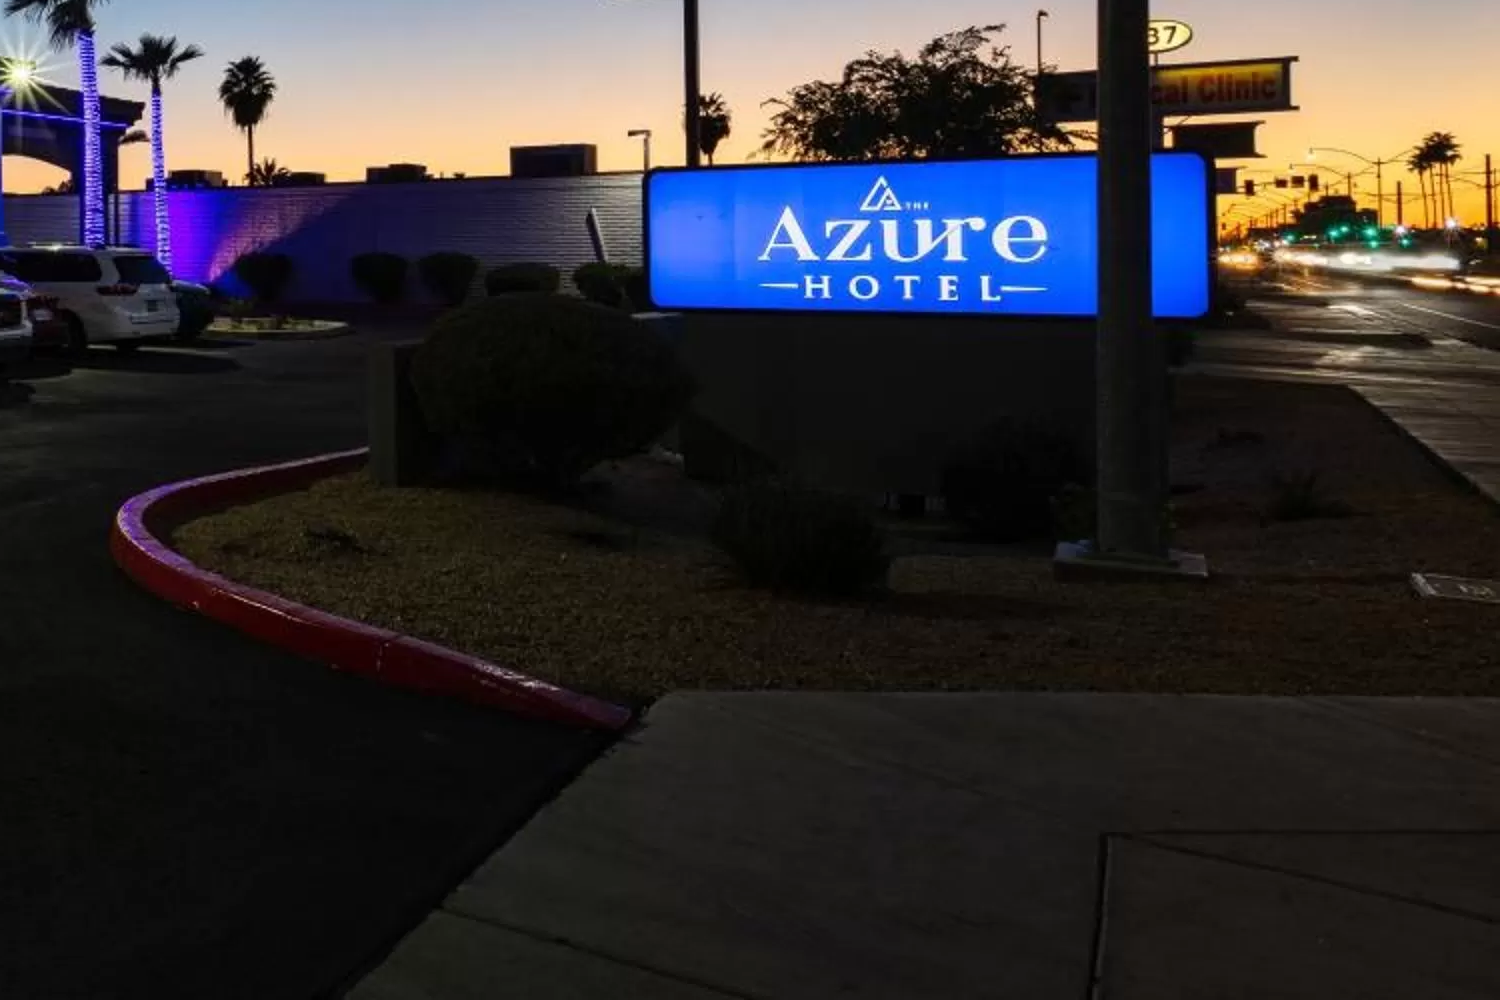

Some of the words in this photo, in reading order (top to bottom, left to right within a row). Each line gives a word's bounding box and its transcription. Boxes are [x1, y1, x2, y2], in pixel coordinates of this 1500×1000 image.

[1197, 71, 1277, 103] Clinic
[757, 205, 1048, 262] Azure
[803, 275, 1002, 301] HOTEL
